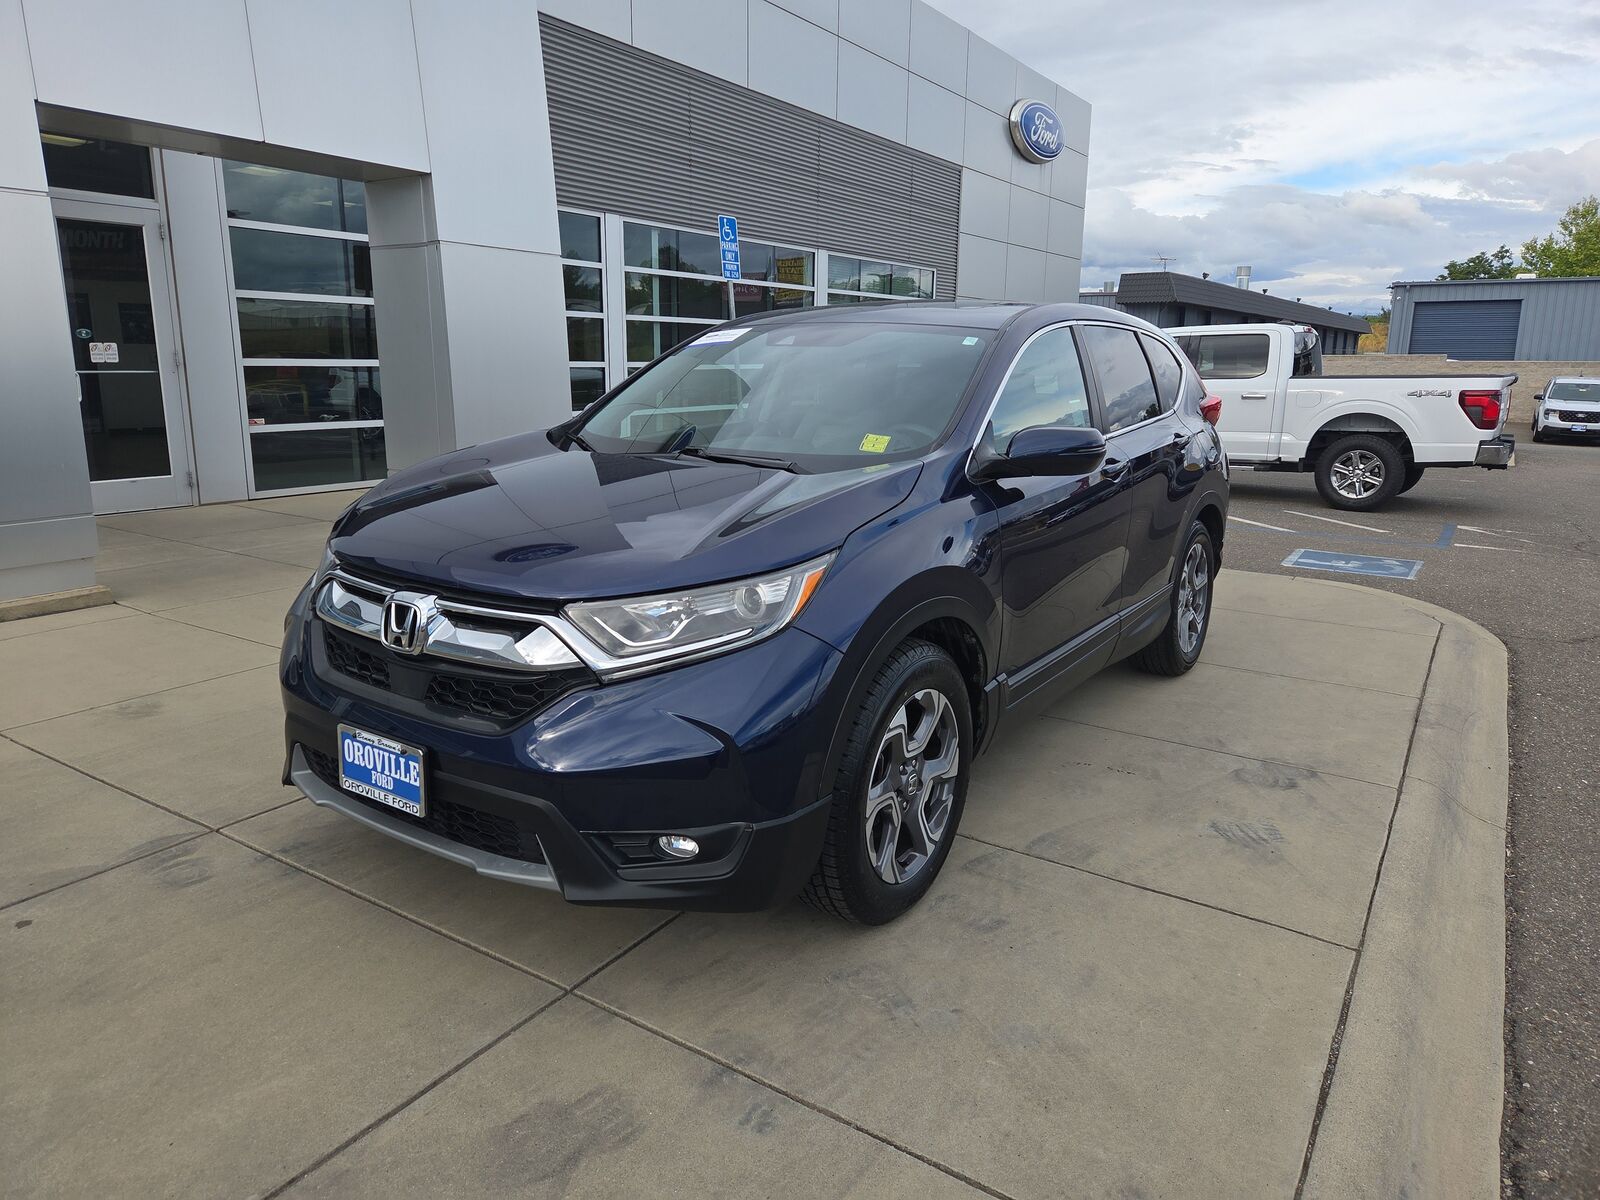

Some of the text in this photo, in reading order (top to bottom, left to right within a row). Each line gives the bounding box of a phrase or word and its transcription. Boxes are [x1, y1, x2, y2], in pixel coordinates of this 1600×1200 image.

[1031, 111, 1059, 150] Ford
[721, 240, 738, 252] PARKING
[725, 250, 735, 261] ONLY
[344, 738, 420, 787] OROVILLE
[371, 770, 394, 790] FORD
[344, 779, 419, 814] OROVILLE FORD
